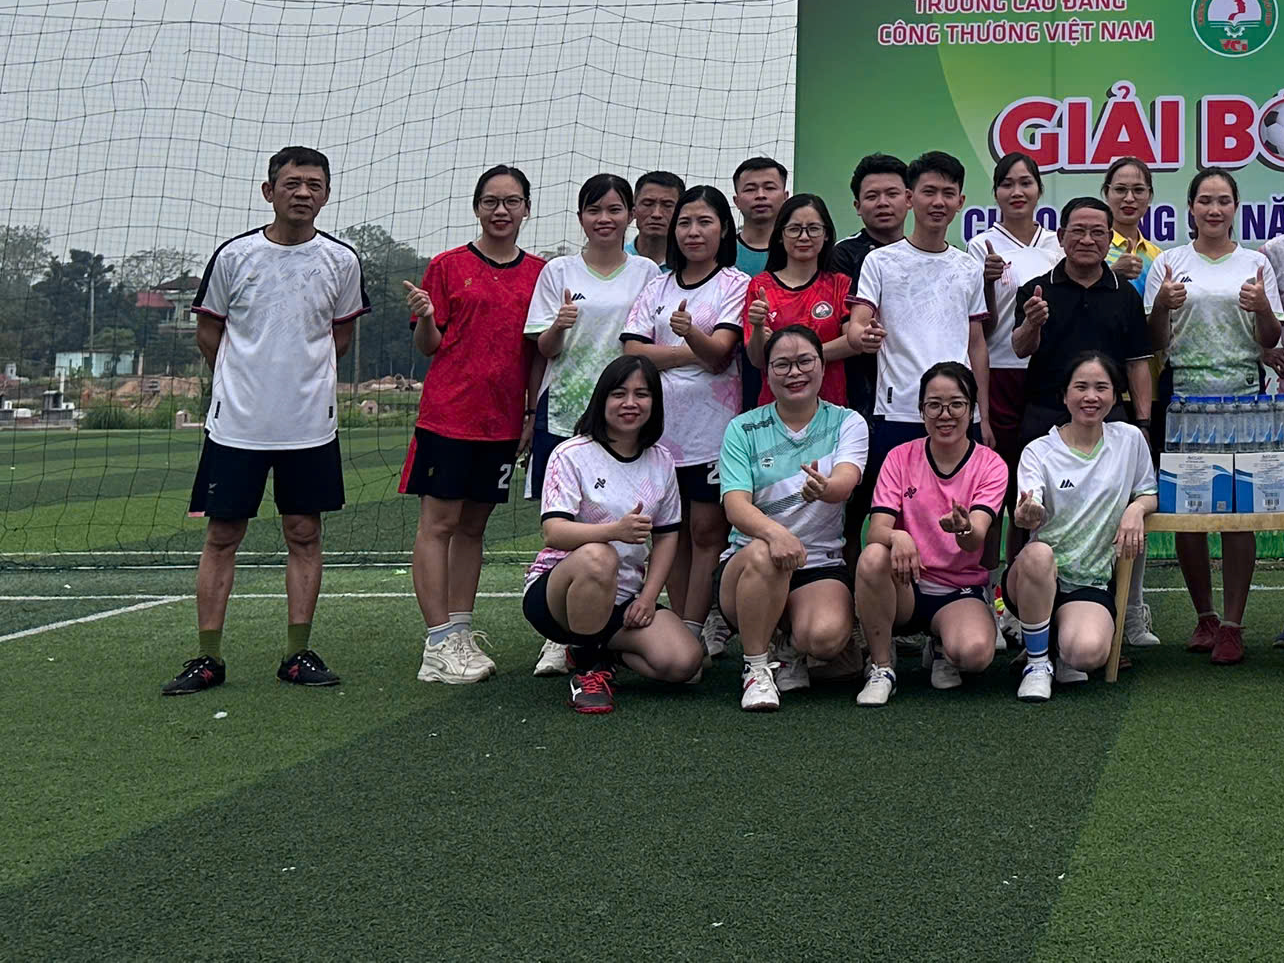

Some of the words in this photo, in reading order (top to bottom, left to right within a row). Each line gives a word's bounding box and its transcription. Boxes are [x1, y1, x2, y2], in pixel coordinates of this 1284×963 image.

[879, 20, 939, 44] CÔNG
[946, 21, 1038, 43] THƯƠNG
[1046, 18, 1093, 45] VIỆT
[1100, 22, 1154, 41] NAM
[998, 84, 1181, 167] GIẢI
